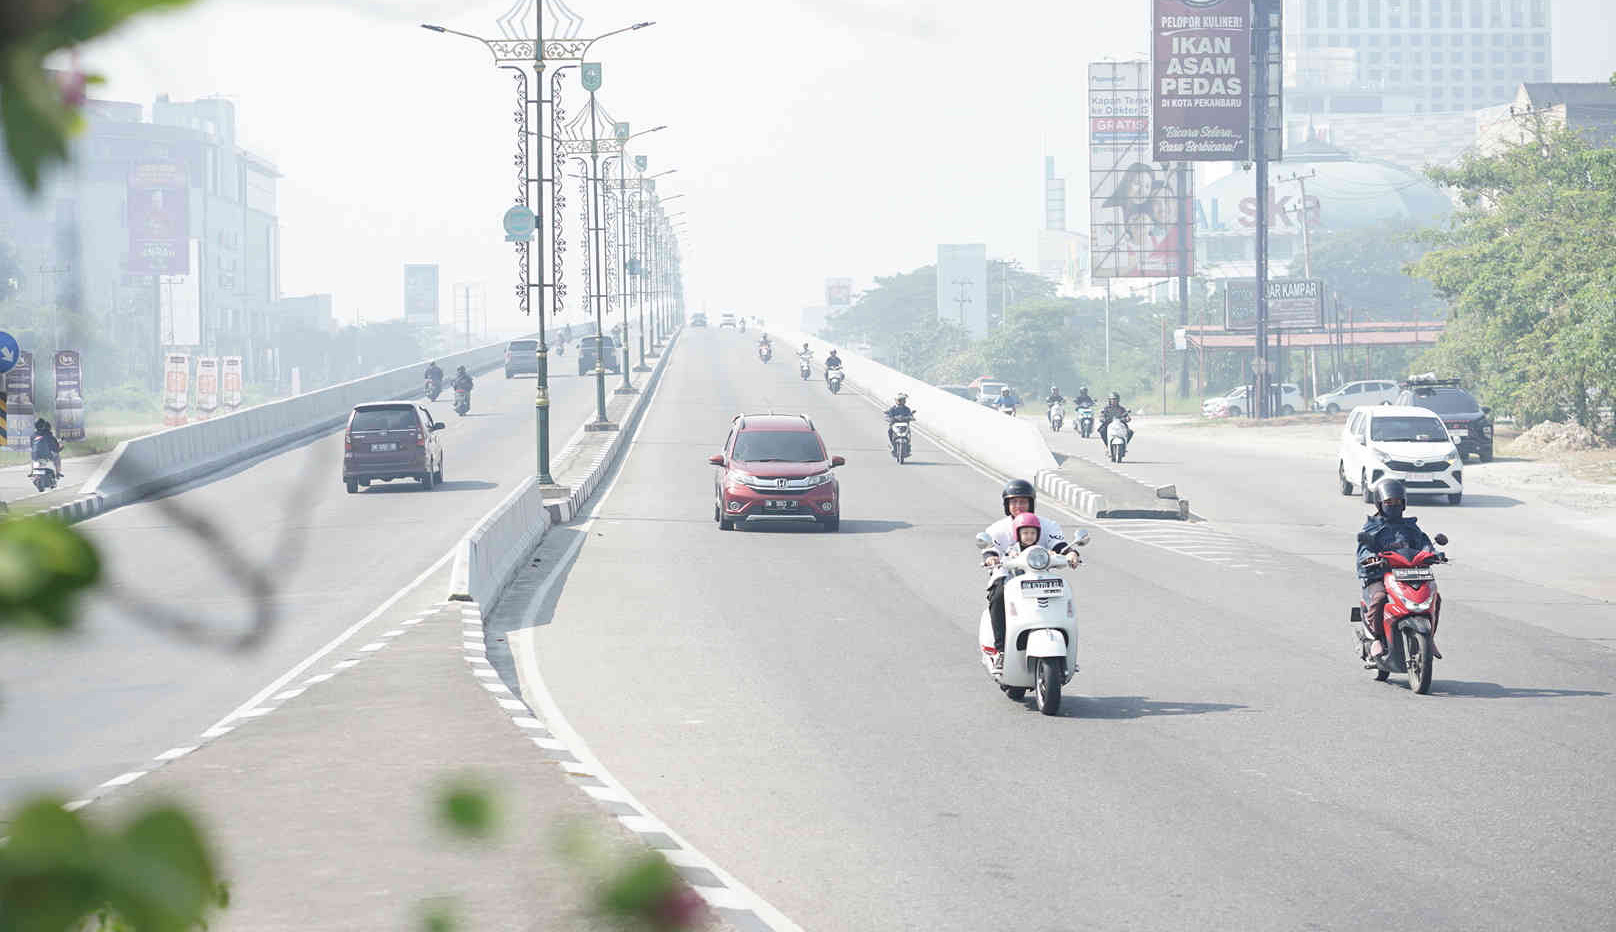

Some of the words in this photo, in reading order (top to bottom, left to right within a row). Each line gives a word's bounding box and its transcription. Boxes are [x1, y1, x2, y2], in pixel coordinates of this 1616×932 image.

[1161, 16, 1201, 28] PELOPOR
[1172, 36, 1231, 54] IKAN
[1166, 57, 1236, 75] ASAM
[1160, 77, 1241, 95] PEDAS
[1161, 99, 1170, 107] DI
[1171, 99, 1192, 107] KOTA
[1193, 98, 1242, 108] PEKANBARU
[1282, 282, 1318, 298] KAMPAR
